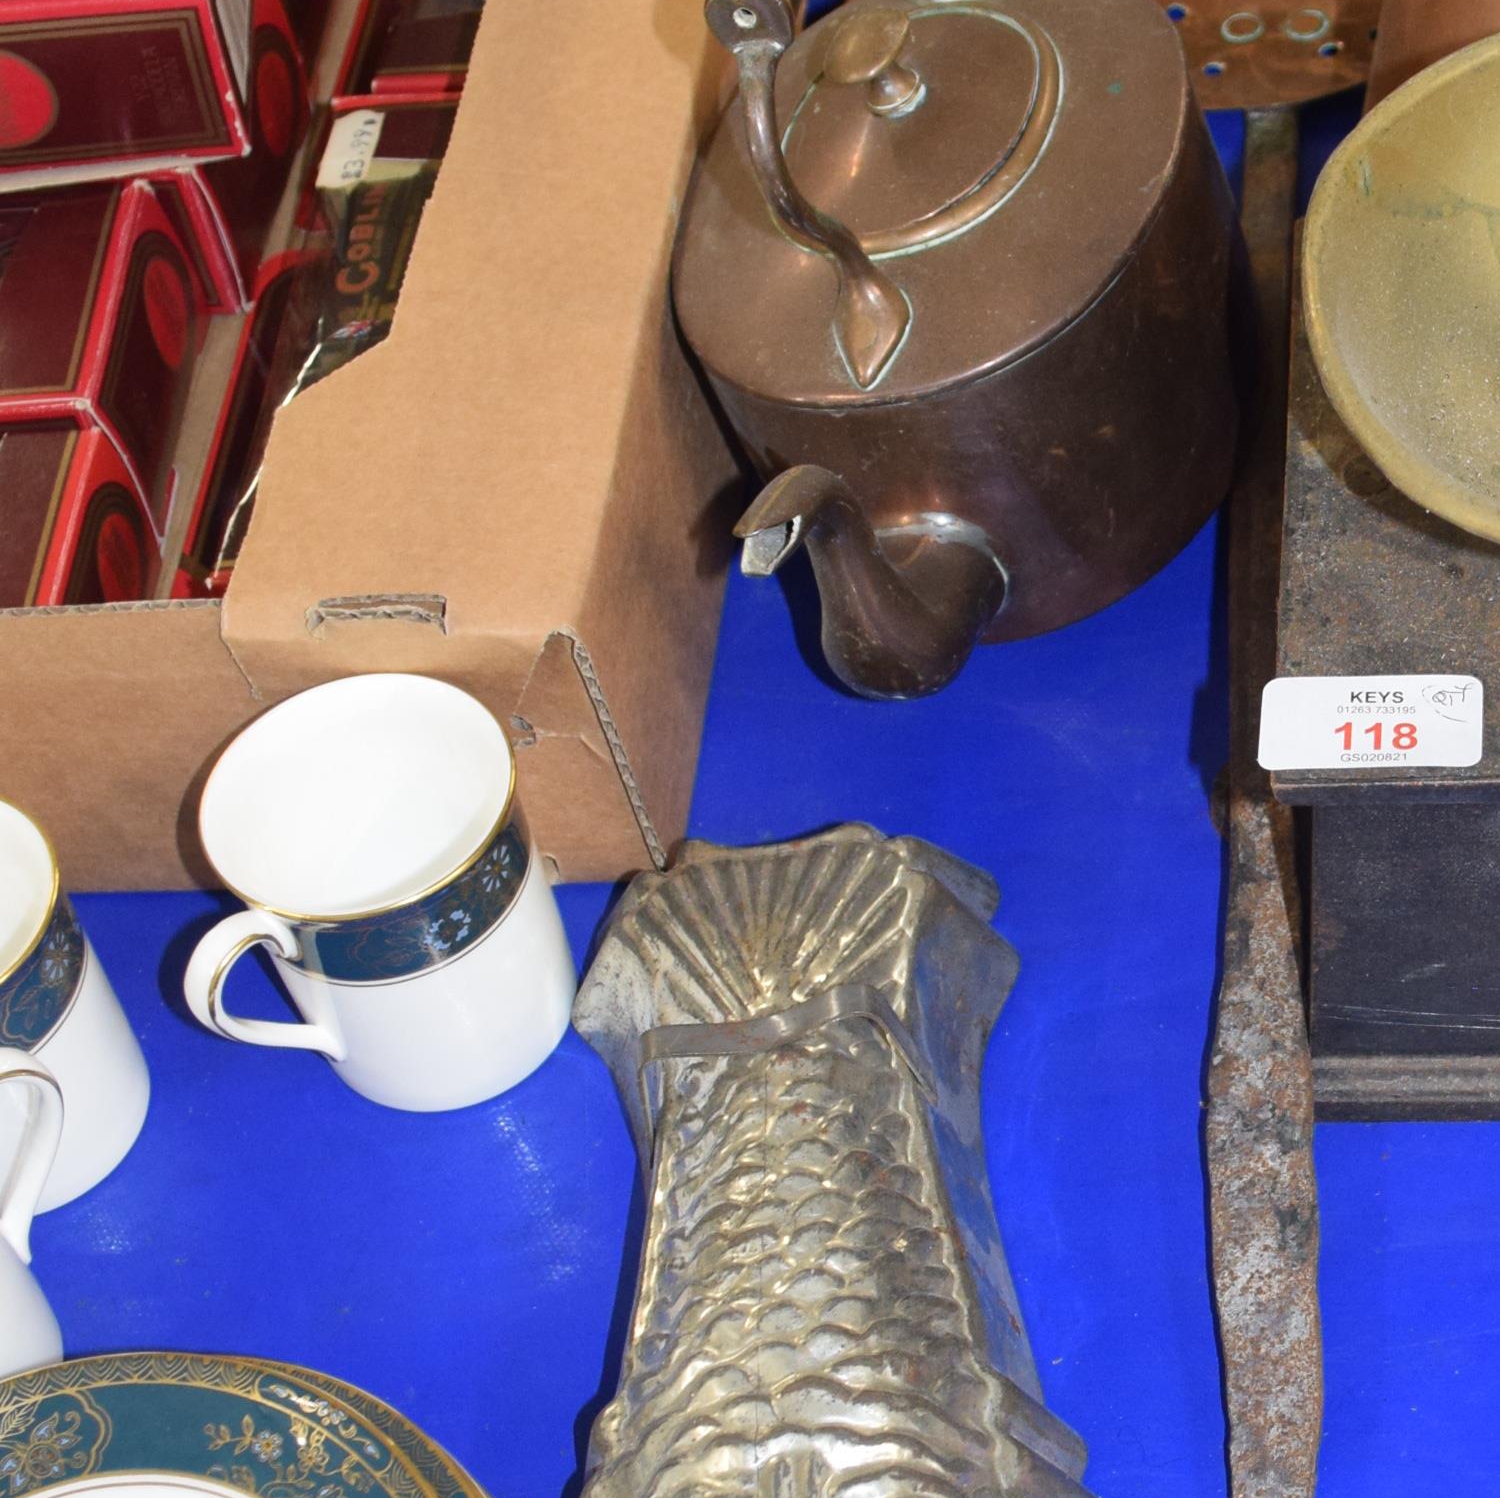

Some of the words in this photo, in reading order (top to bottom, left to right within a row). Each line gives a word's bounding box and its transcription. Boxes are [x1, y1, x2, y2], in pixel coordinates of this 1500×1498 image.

[1350, 691, 1404, 704] KEYS
[1337, 705, 1372, 714] 01263
[1375, 705, 1416, 714] 733195
[1335, 721, 1418, 751] 118
[1340, 753, 1407, 763] GS020821
